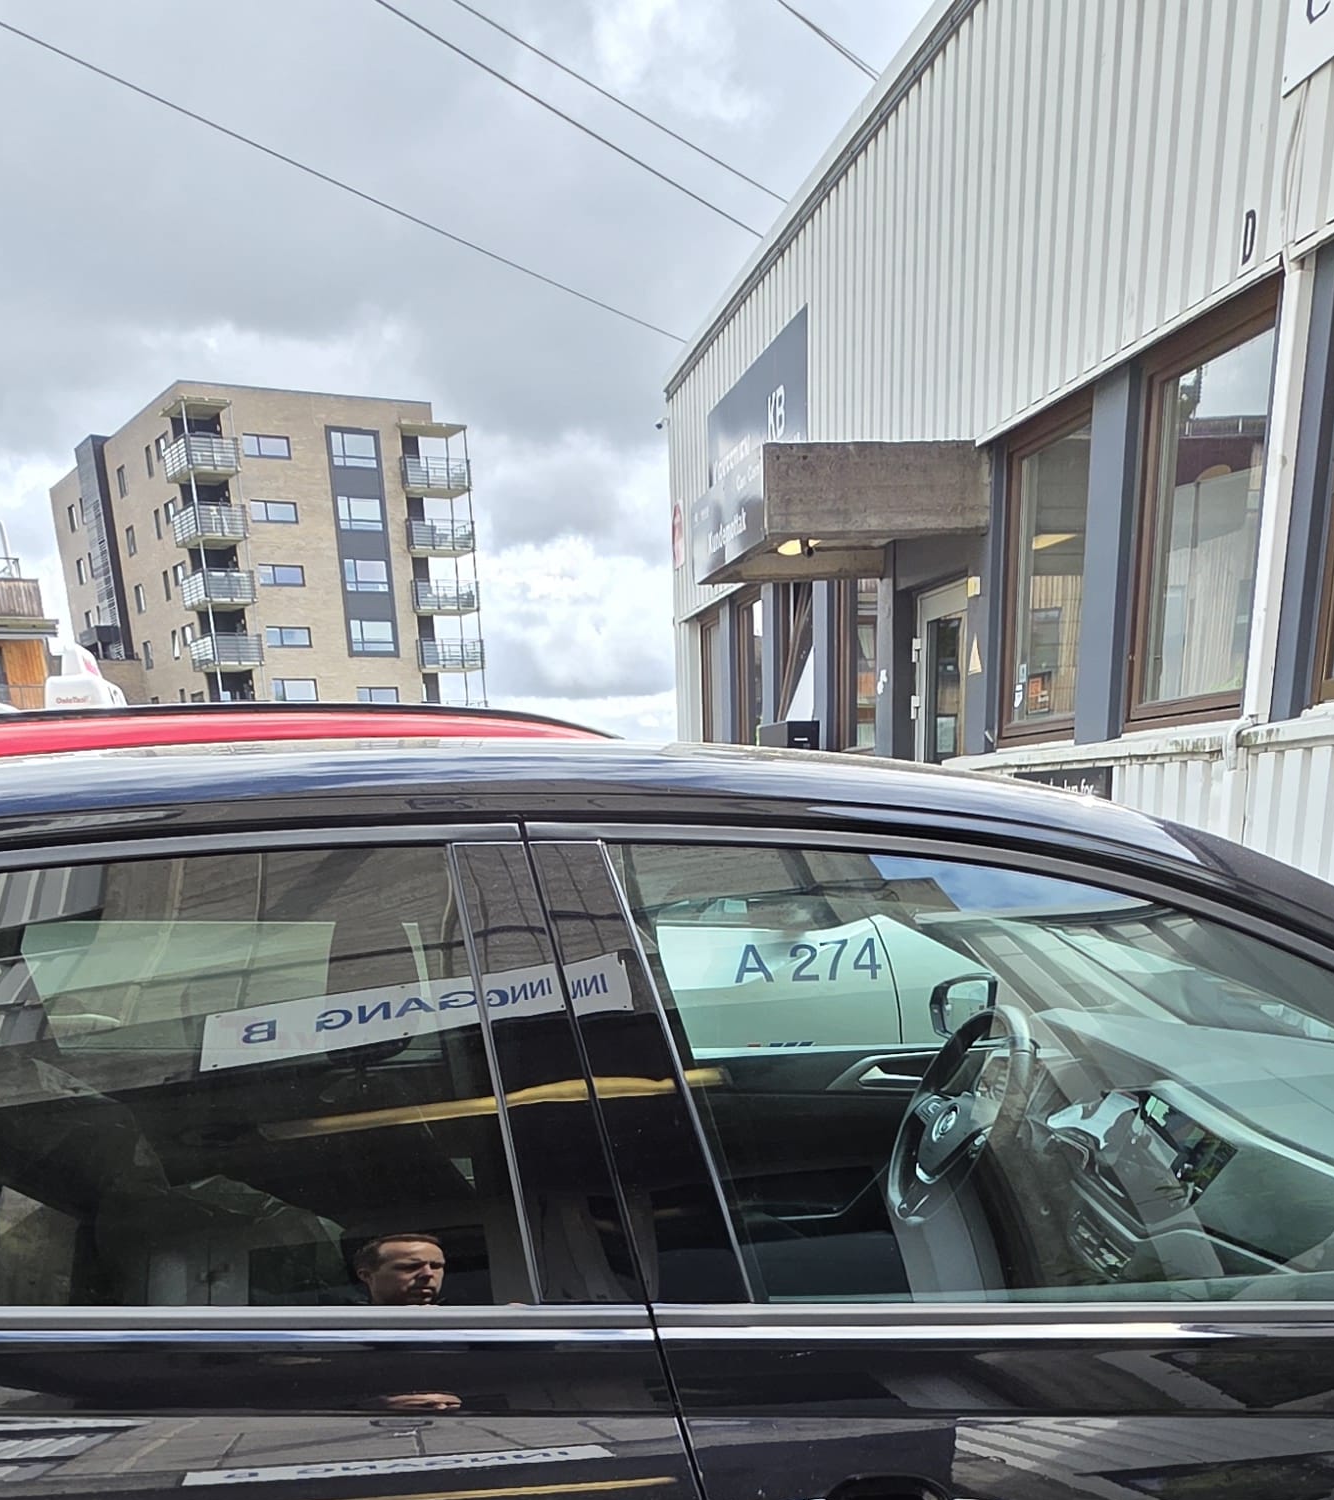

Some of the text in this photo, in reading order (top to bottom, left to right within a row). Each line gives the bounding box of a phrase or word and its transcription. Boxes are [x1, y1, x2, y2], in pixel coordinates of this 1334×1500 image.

[1241, 208, 1256, 266] D
[768, 384, 786, 441] KB
[734, 938, 882, 984] A 274
